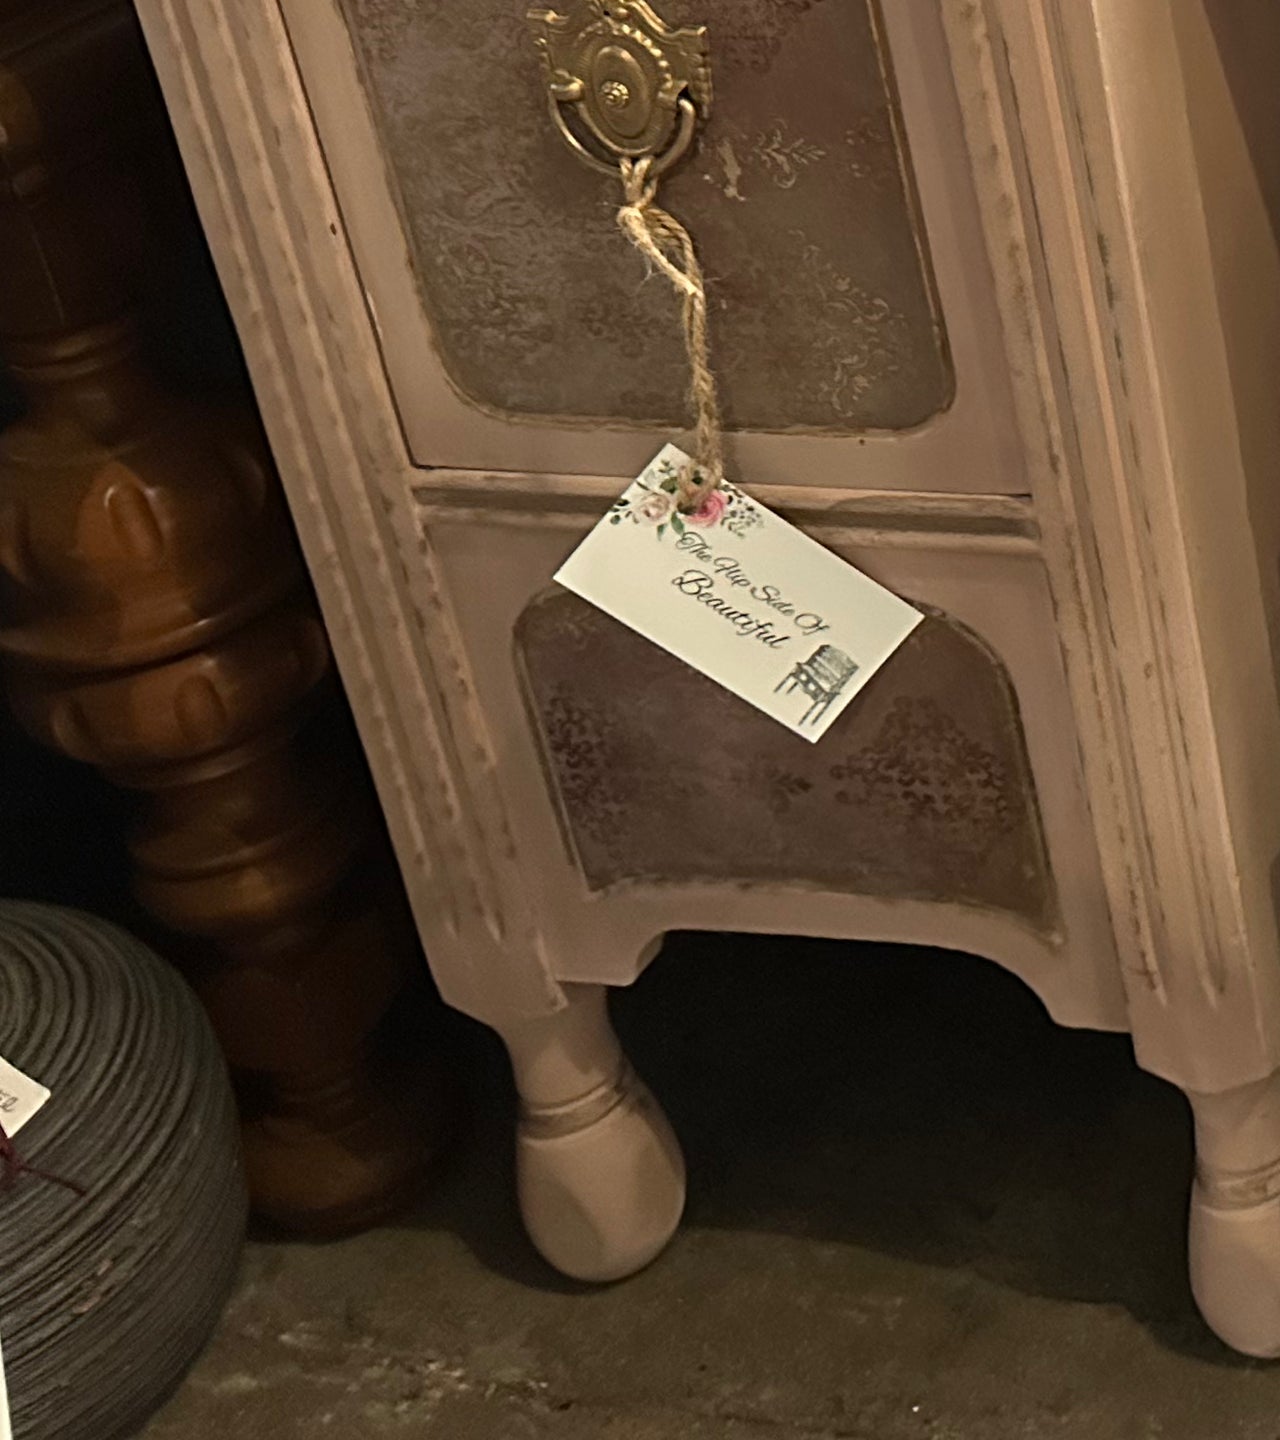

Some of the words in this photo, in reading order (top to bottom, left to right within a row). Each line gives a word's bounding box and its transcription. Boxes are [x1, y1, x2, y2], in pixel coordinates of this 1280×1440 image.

[671, 569, 791, 649] Beautiful
[674, 531, 713, 564] The
[713, 556, 750, 591] Flip
[750, 585, 794, 617] Side
[794, 612, 831, 637] Of
